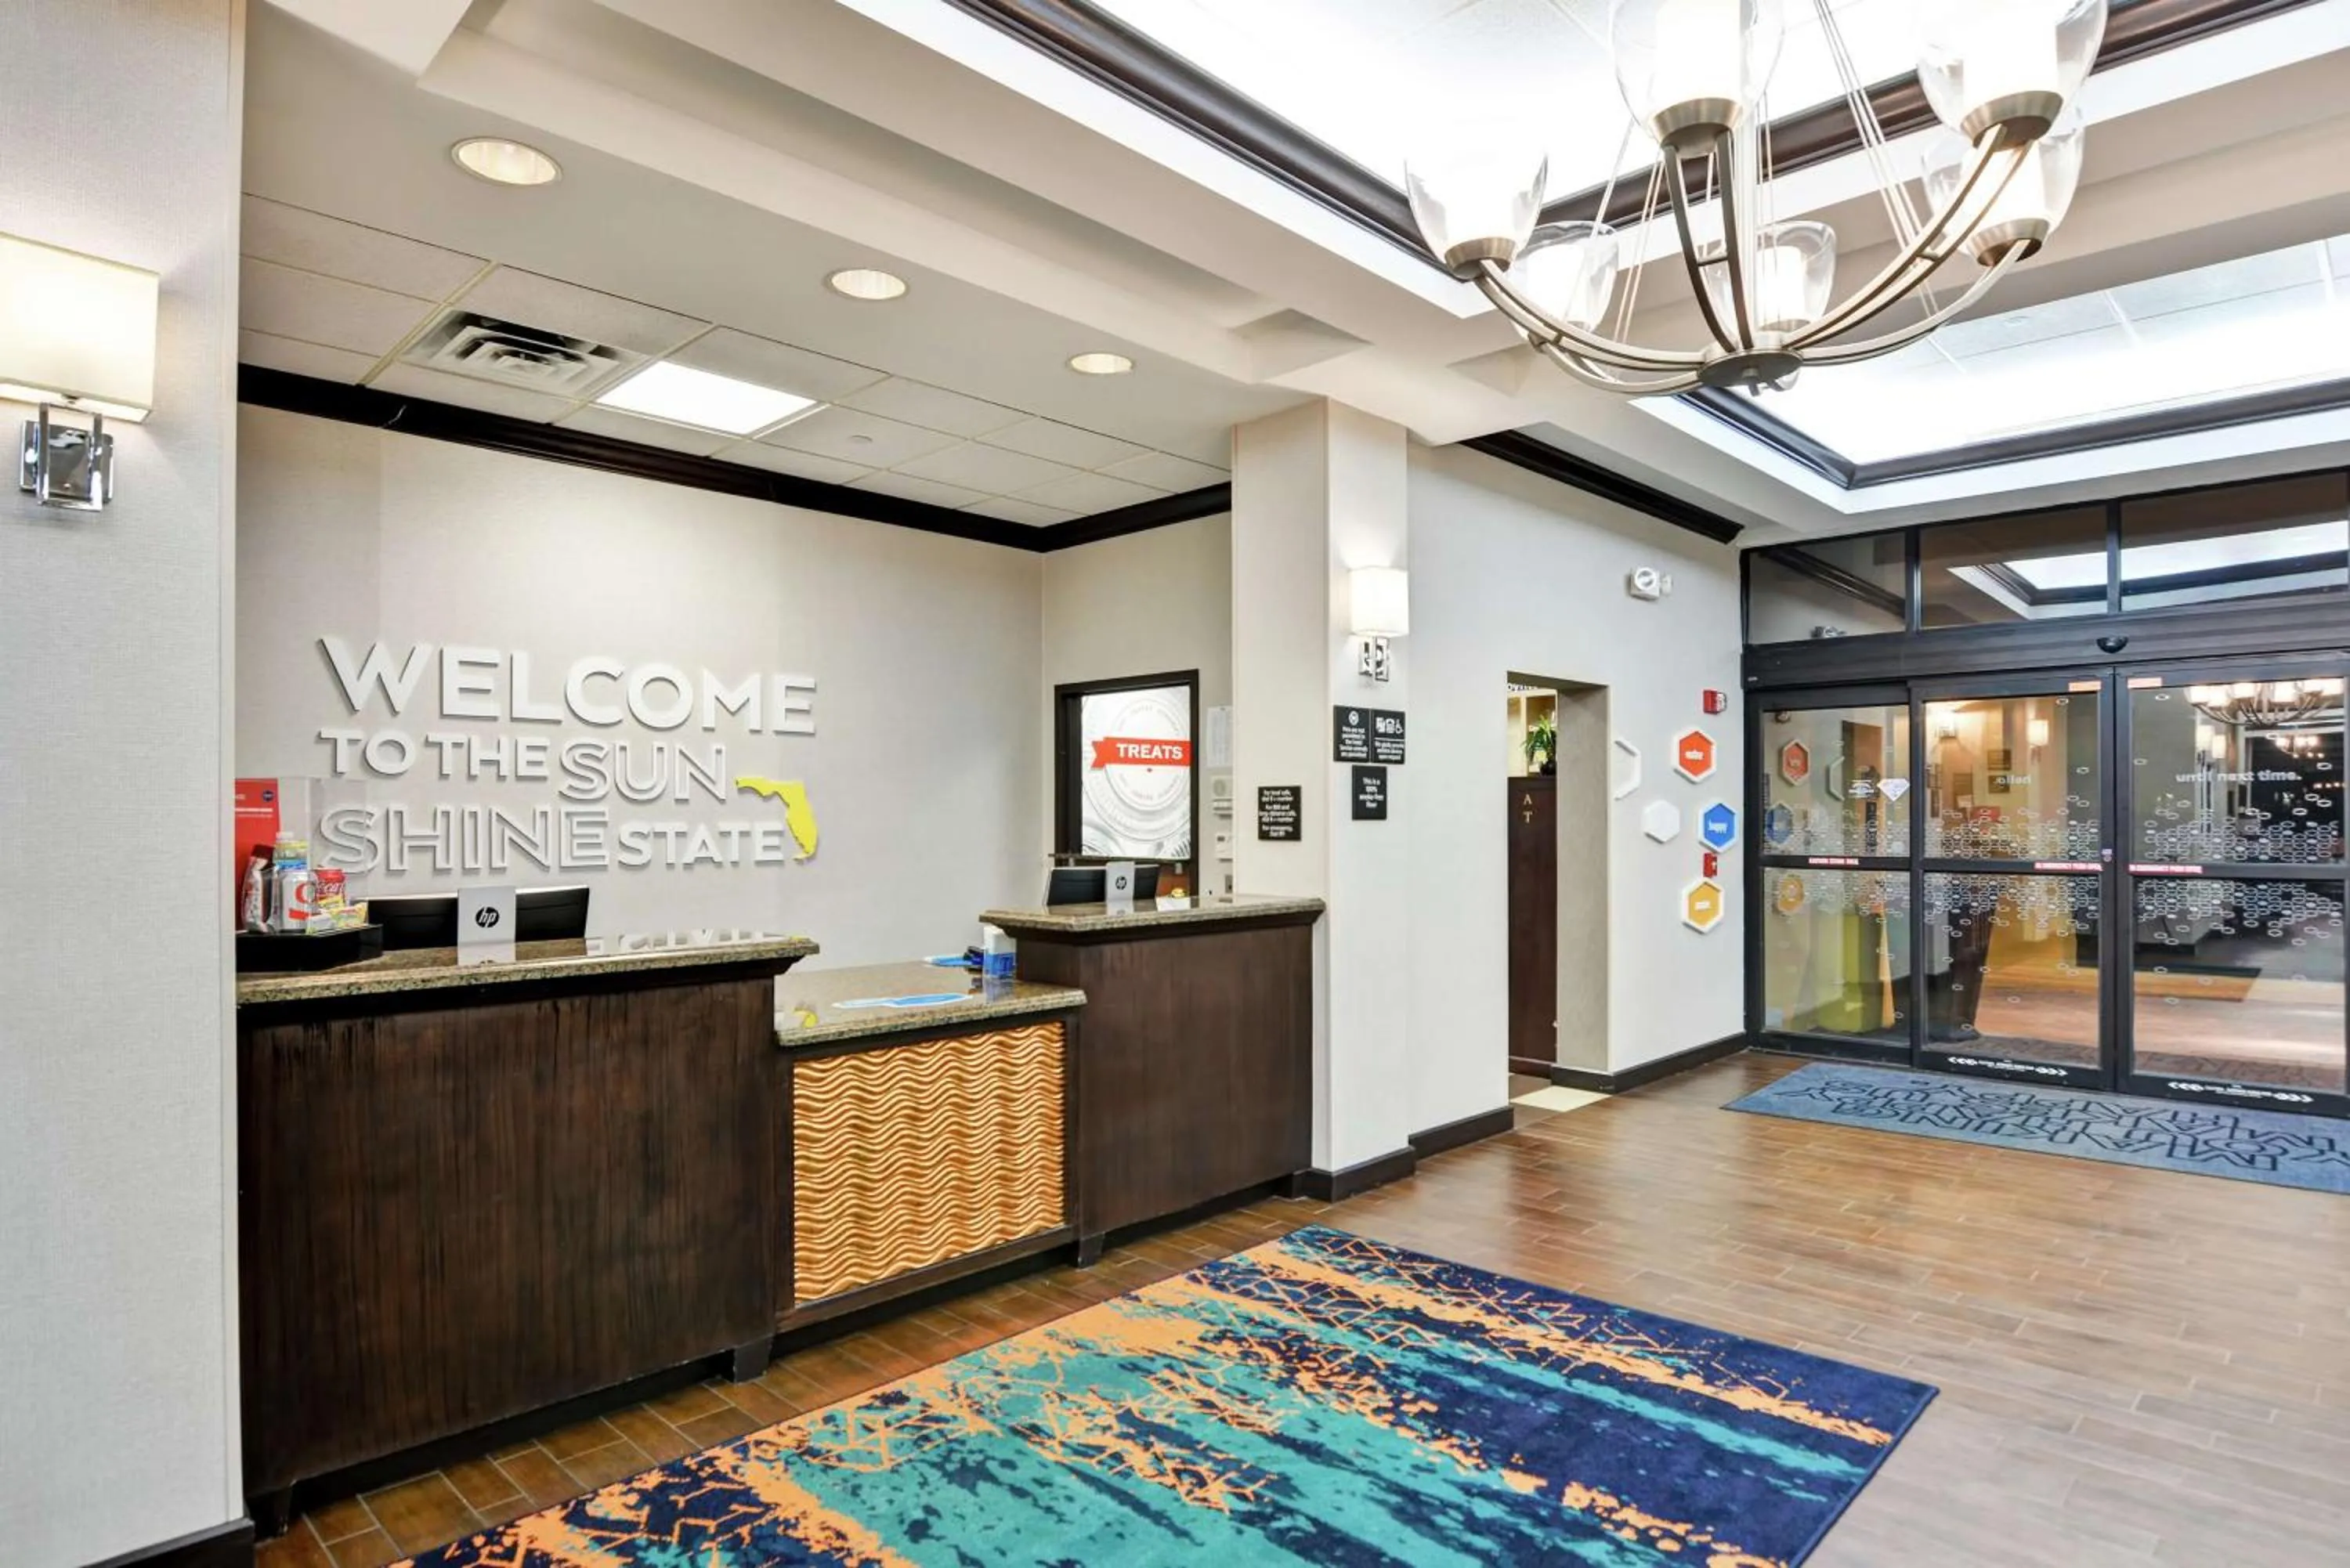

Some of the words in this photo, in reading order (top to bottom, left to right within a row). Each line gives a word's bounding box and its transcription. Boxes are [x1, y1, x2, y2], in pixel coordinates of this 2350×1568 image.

[318, 635, 816, 735] WELCOME
[318, 728, 415, 775] TO
[425, 733, 548, 779] THE
[559, 739, 727, 800] SUN
[1116, 742, 1184, 760] TREATS
[2175, 768, 2213, 782] until
[2217, 771, 2254, 782] next
[2258, 769, 2302, 782] time.
[319, 802, 609, 874] SHINE
[617, 821, 784, 865] STATE
[476, 906, 499, 930] hp
